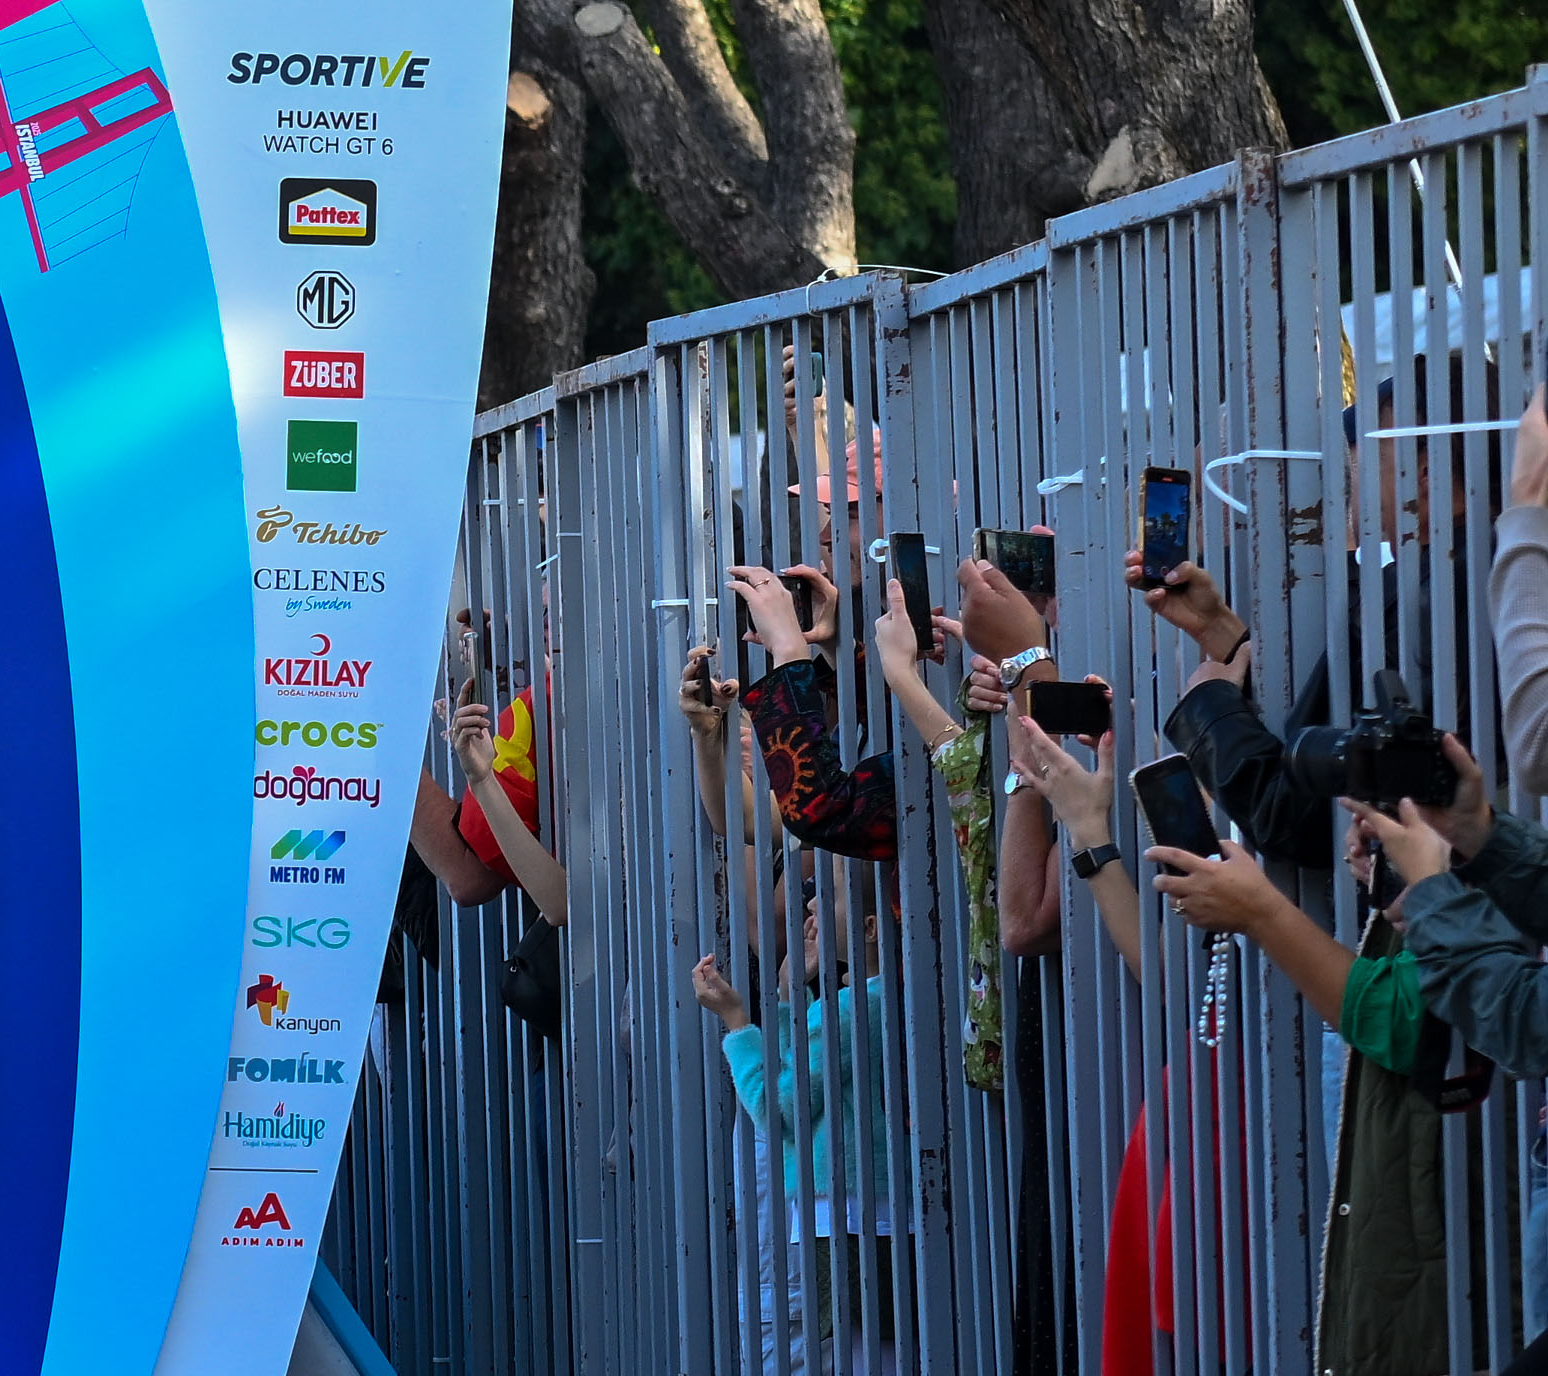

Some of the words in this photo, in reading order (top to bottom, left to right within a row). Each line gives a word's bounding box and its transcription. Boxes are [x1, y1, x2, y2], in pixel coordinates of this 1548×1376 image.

[227, 50, 429, 88] SPORTIVE
[278, 110, 377, 131] HUAWEI
[263, 135, 339, 154] WATCH
[347, 137, 376, 154] GT
[382, 138, 393, 155] 6
[296, 205, 360, 224] Pattex
[303, 276, 349, 324] MG
[293, 450, 352, 465] wefood
[293, 522, 388, 545] Tchibo
[253, 568, 385, 592] CELENES
[265, 658, 372, 687] KIZILAY
[256, 720, 377, 748] crocs
[270, 867, 319, 884] METRO
[325, 868, 345, 884] FM
[252, 916, 350, 949] SKG
[223, 1111, 325, 1147] Hamidiye
[222, 1237, 259, 1247] ADIM
[266, 1238, 303, 1247] ADIM
